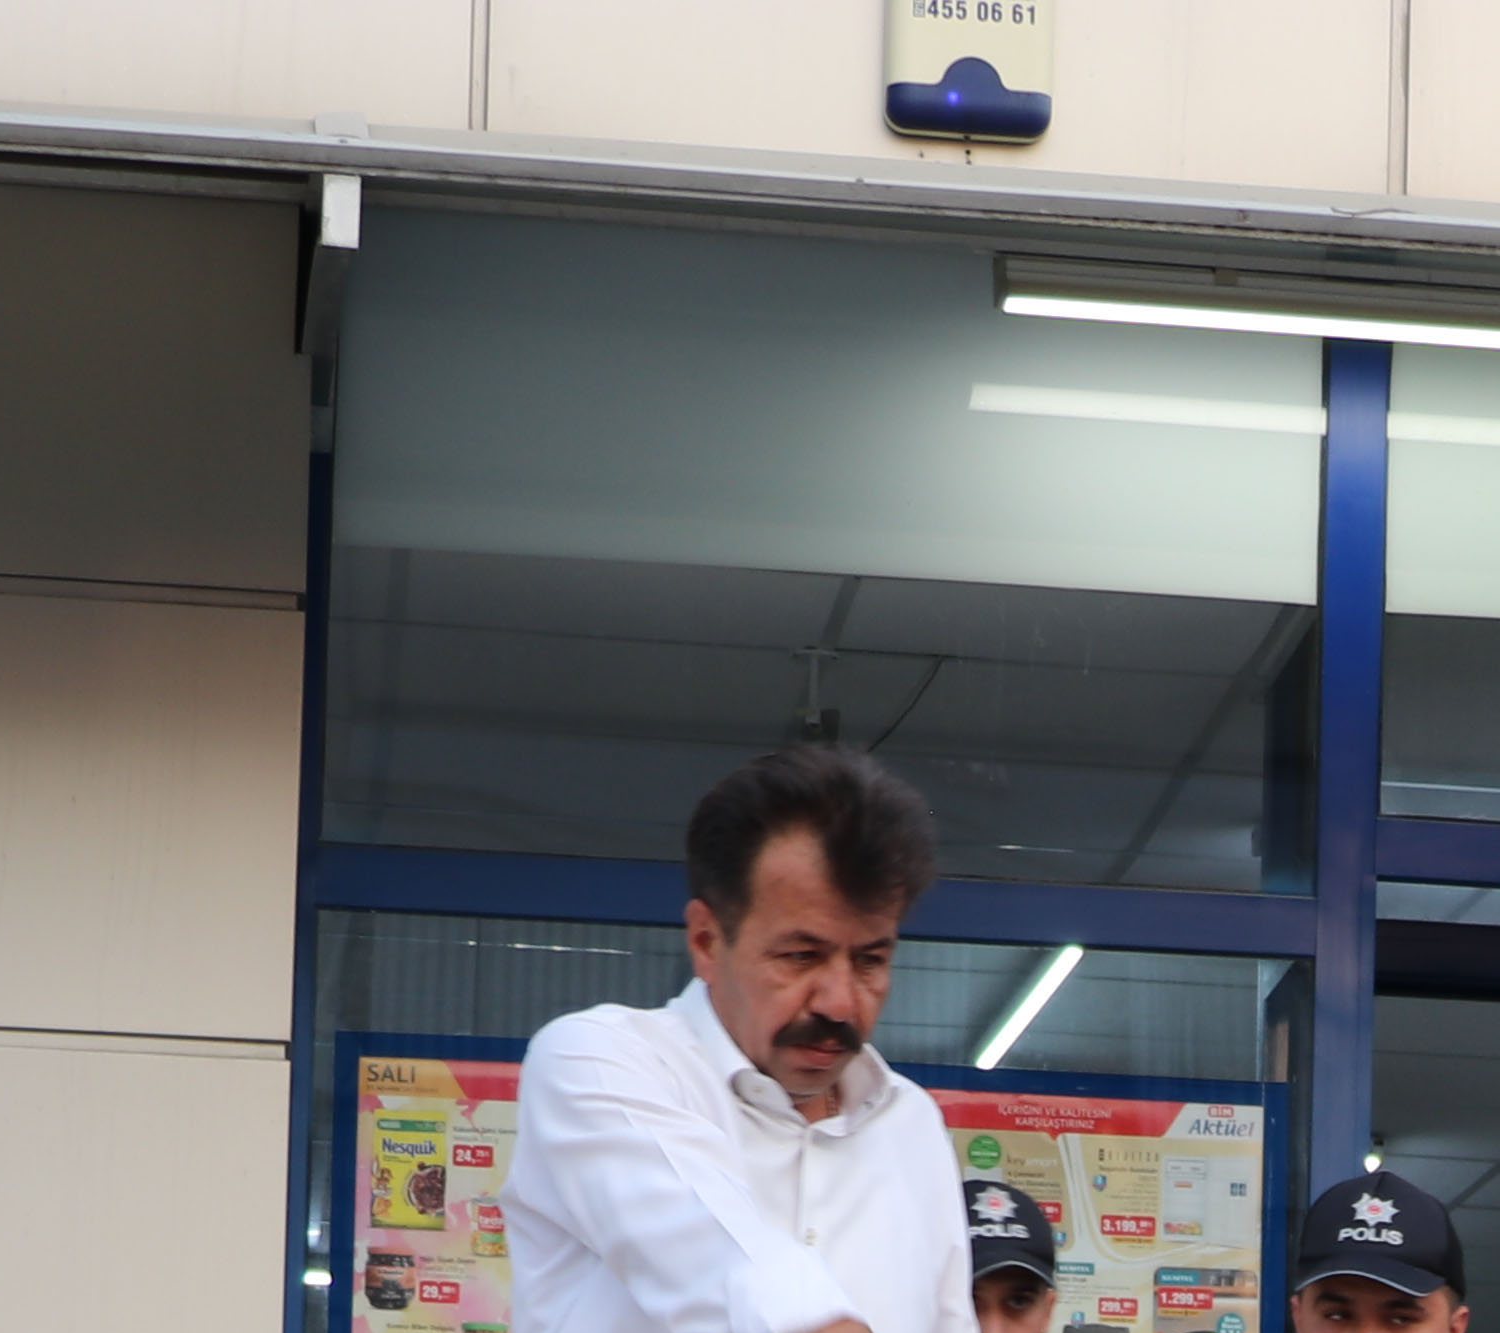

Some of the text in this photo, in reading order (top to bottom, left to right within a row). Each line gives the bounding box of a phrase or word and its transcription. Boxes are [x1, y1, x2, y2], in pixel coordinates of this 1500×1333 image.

[977, 1, 1003, 22] 06
[1012, 4, 1036, 25] 61
[1044, 1105, 1057, 1116] VE
[1188, 1118, 1254, 1137] Aktüel
[382, 1137, 436, 1157] Nesquik
